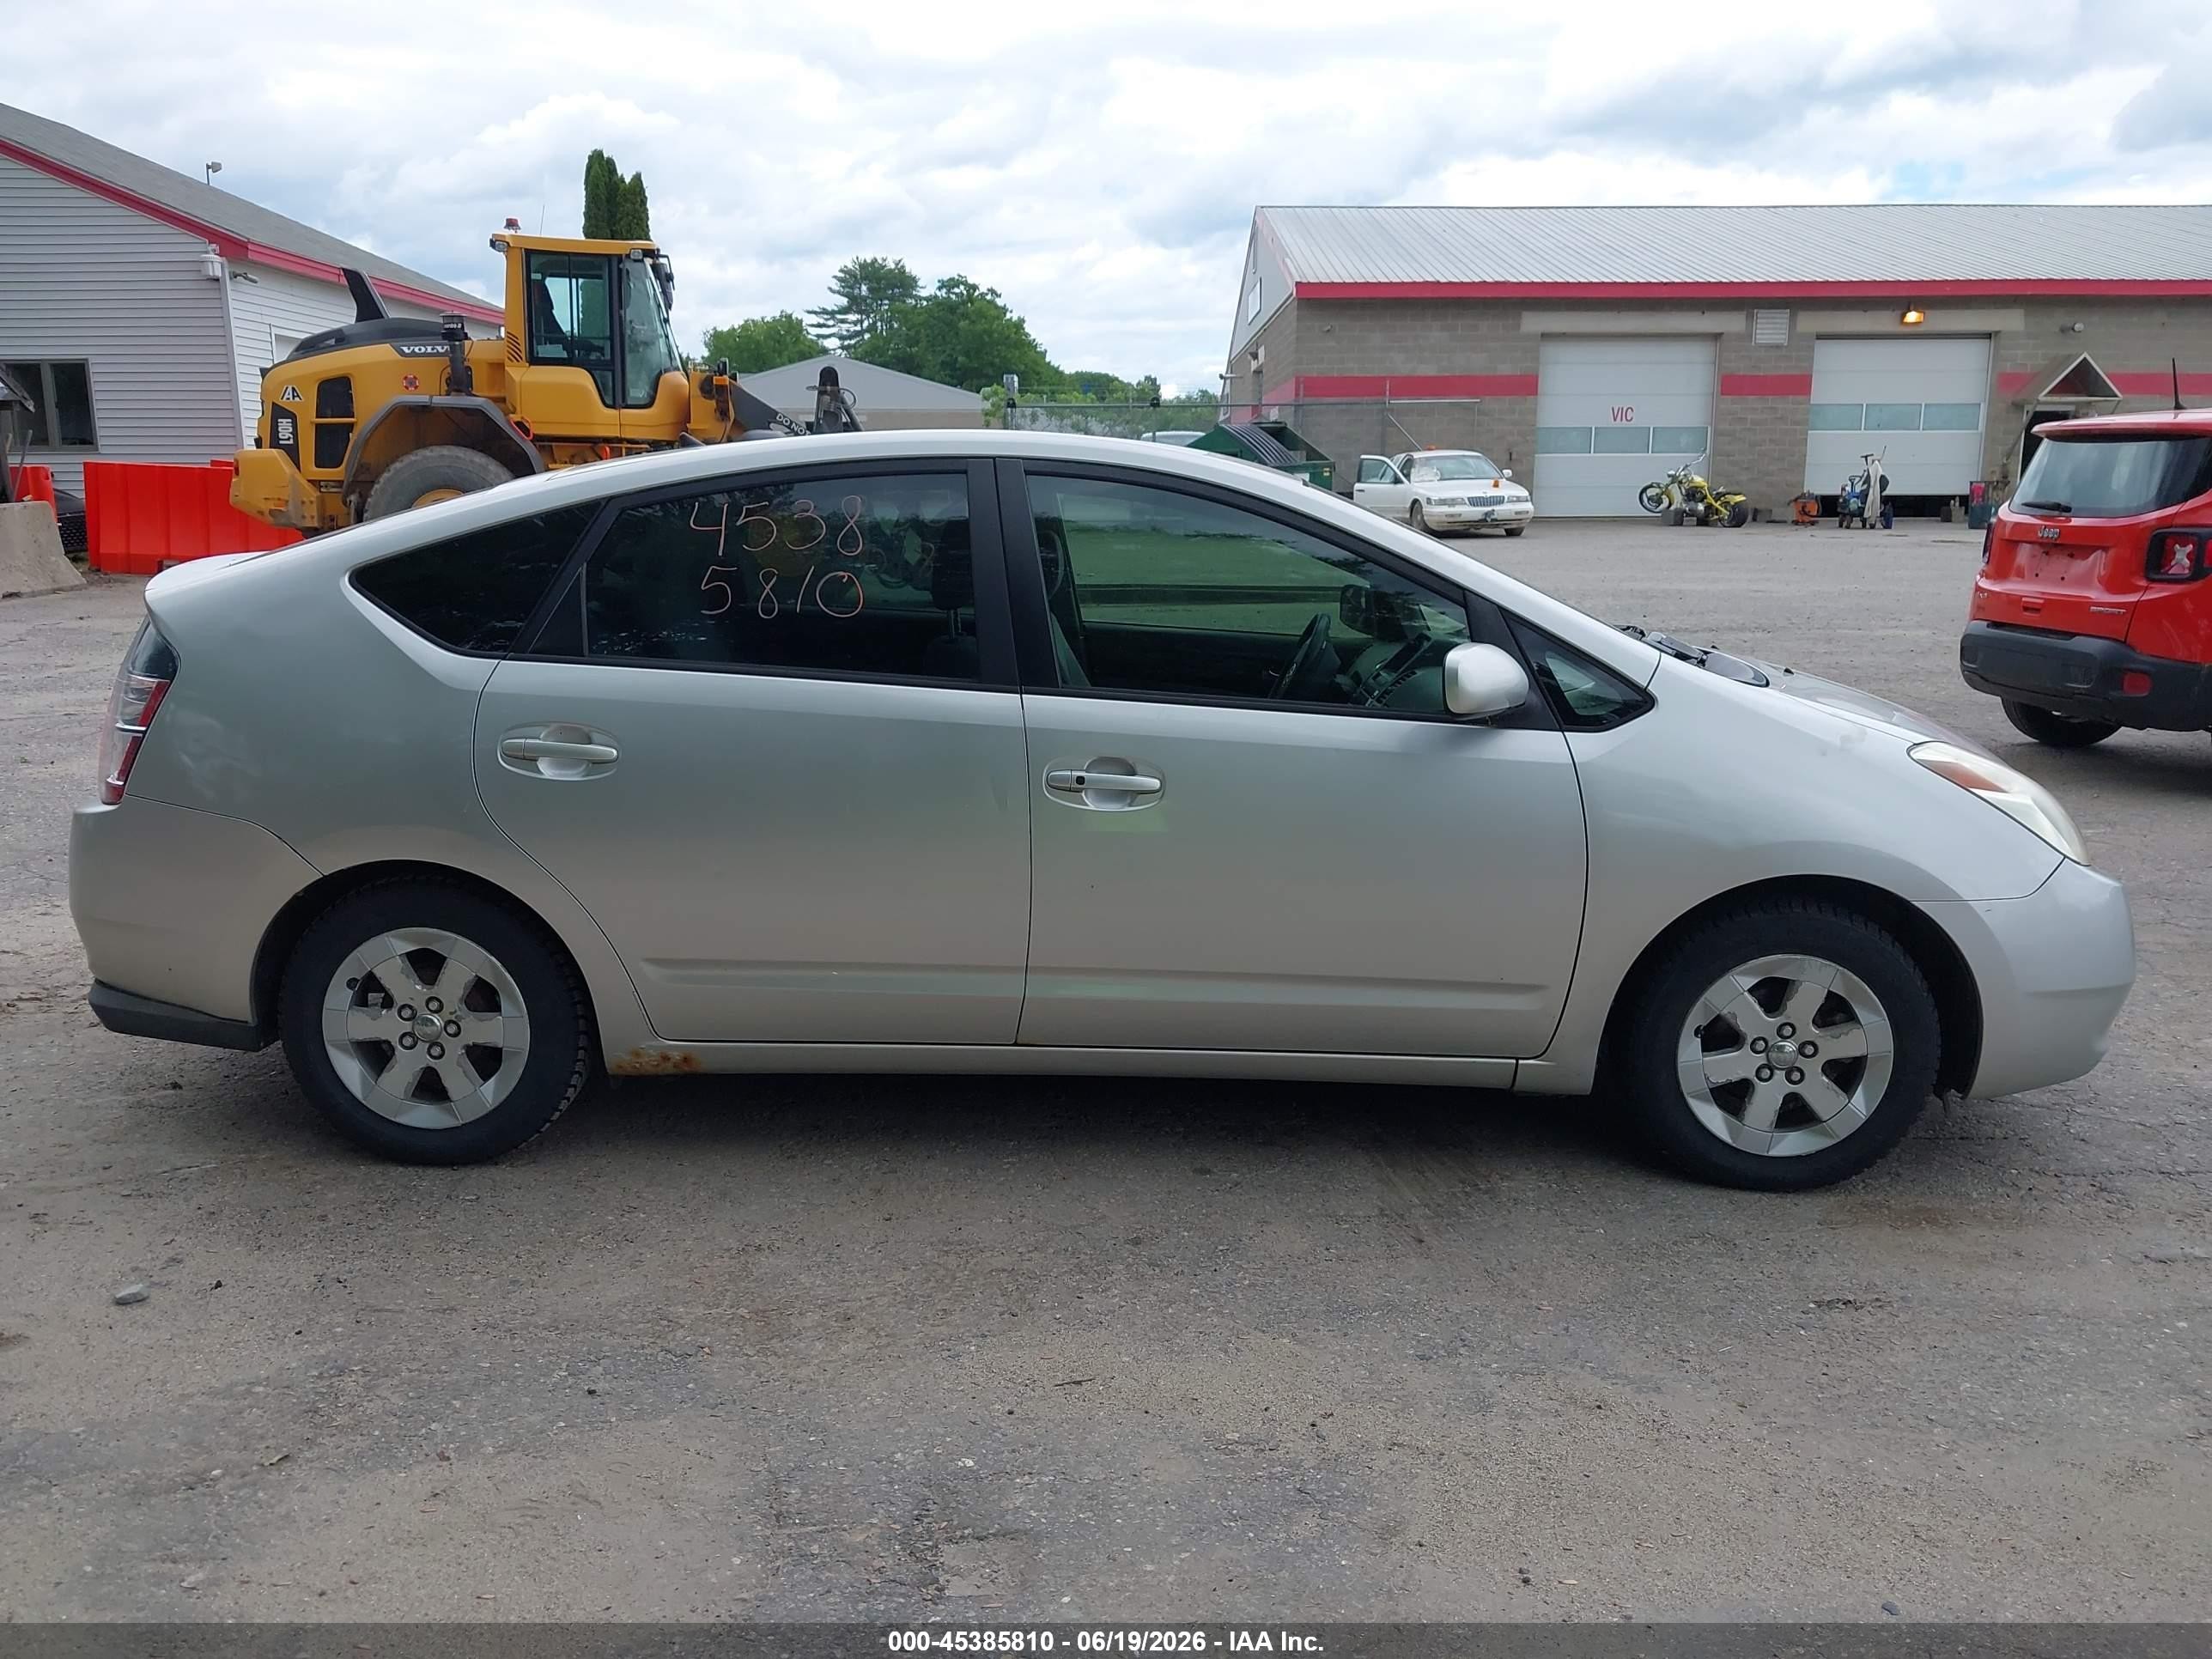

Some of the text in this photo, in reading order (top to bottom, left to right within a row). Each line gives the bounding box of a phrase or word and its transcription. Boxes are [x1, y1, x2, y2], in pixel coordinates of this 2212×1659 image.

[400, 345, 451, 354] VOLV
[776, 413, 791, 426] DO
[1611, 406, 1634, 422] VIC
[277, 418, 294, 445] L90H
[690, 495, 864, 557] 4538
[2038, 525, 2060, 540] Jeep
[700, 564, 865, 620] 5810
